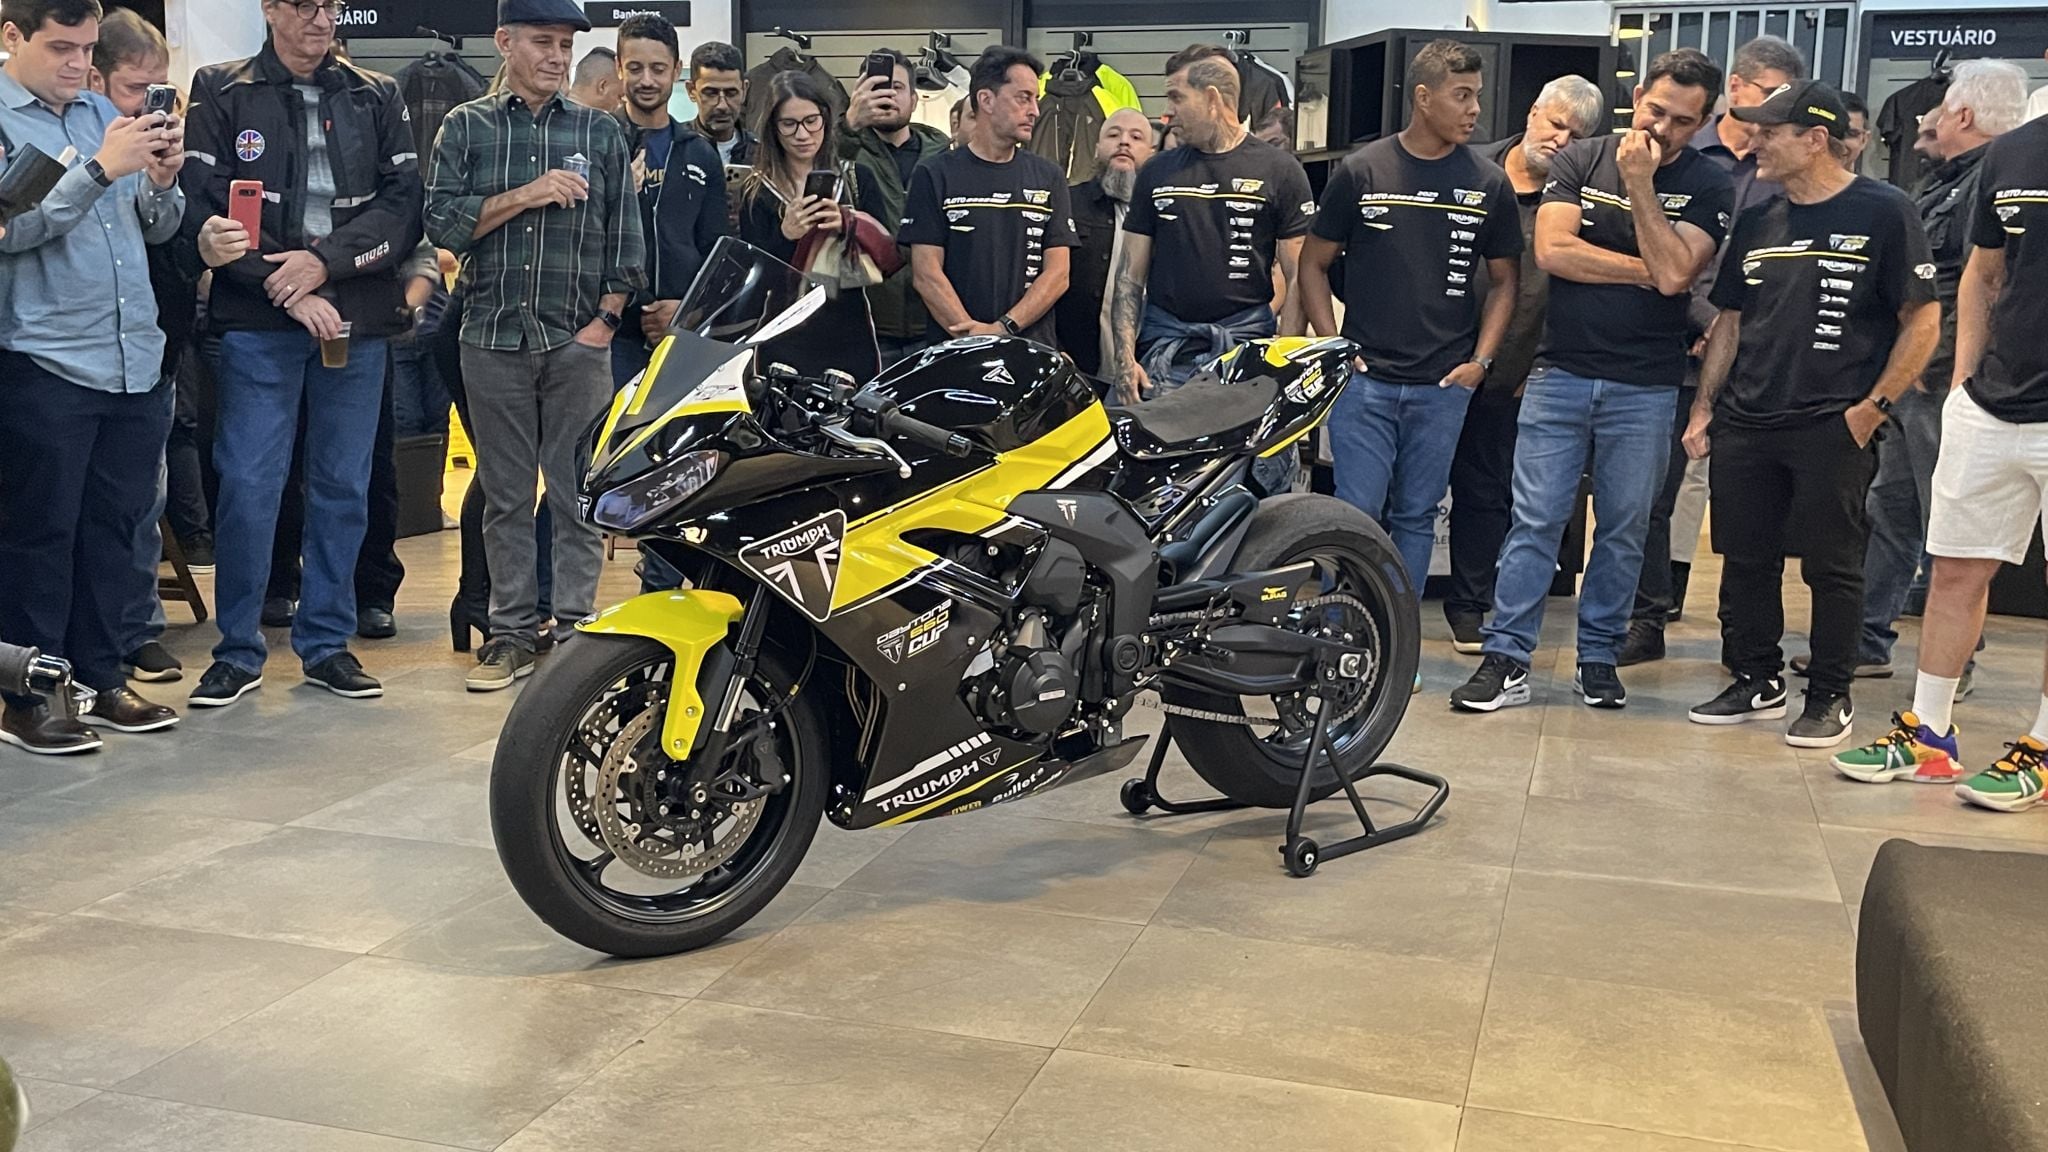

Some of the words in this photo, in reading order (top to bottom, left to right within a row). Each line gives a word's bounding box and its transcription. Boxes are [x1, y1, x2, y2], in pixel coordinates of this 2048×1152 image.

[1890, 25, 1997, 46] VESTUÁRIO
[1447, 212, 1480, 225] TRIUMPH
[760, 523, 831, 560] TRIUMPH
[907, 620, 950, 656] CUP
[910, 609, 949, 639] 660
[876, 760, 980, 813] TRIUMPH
